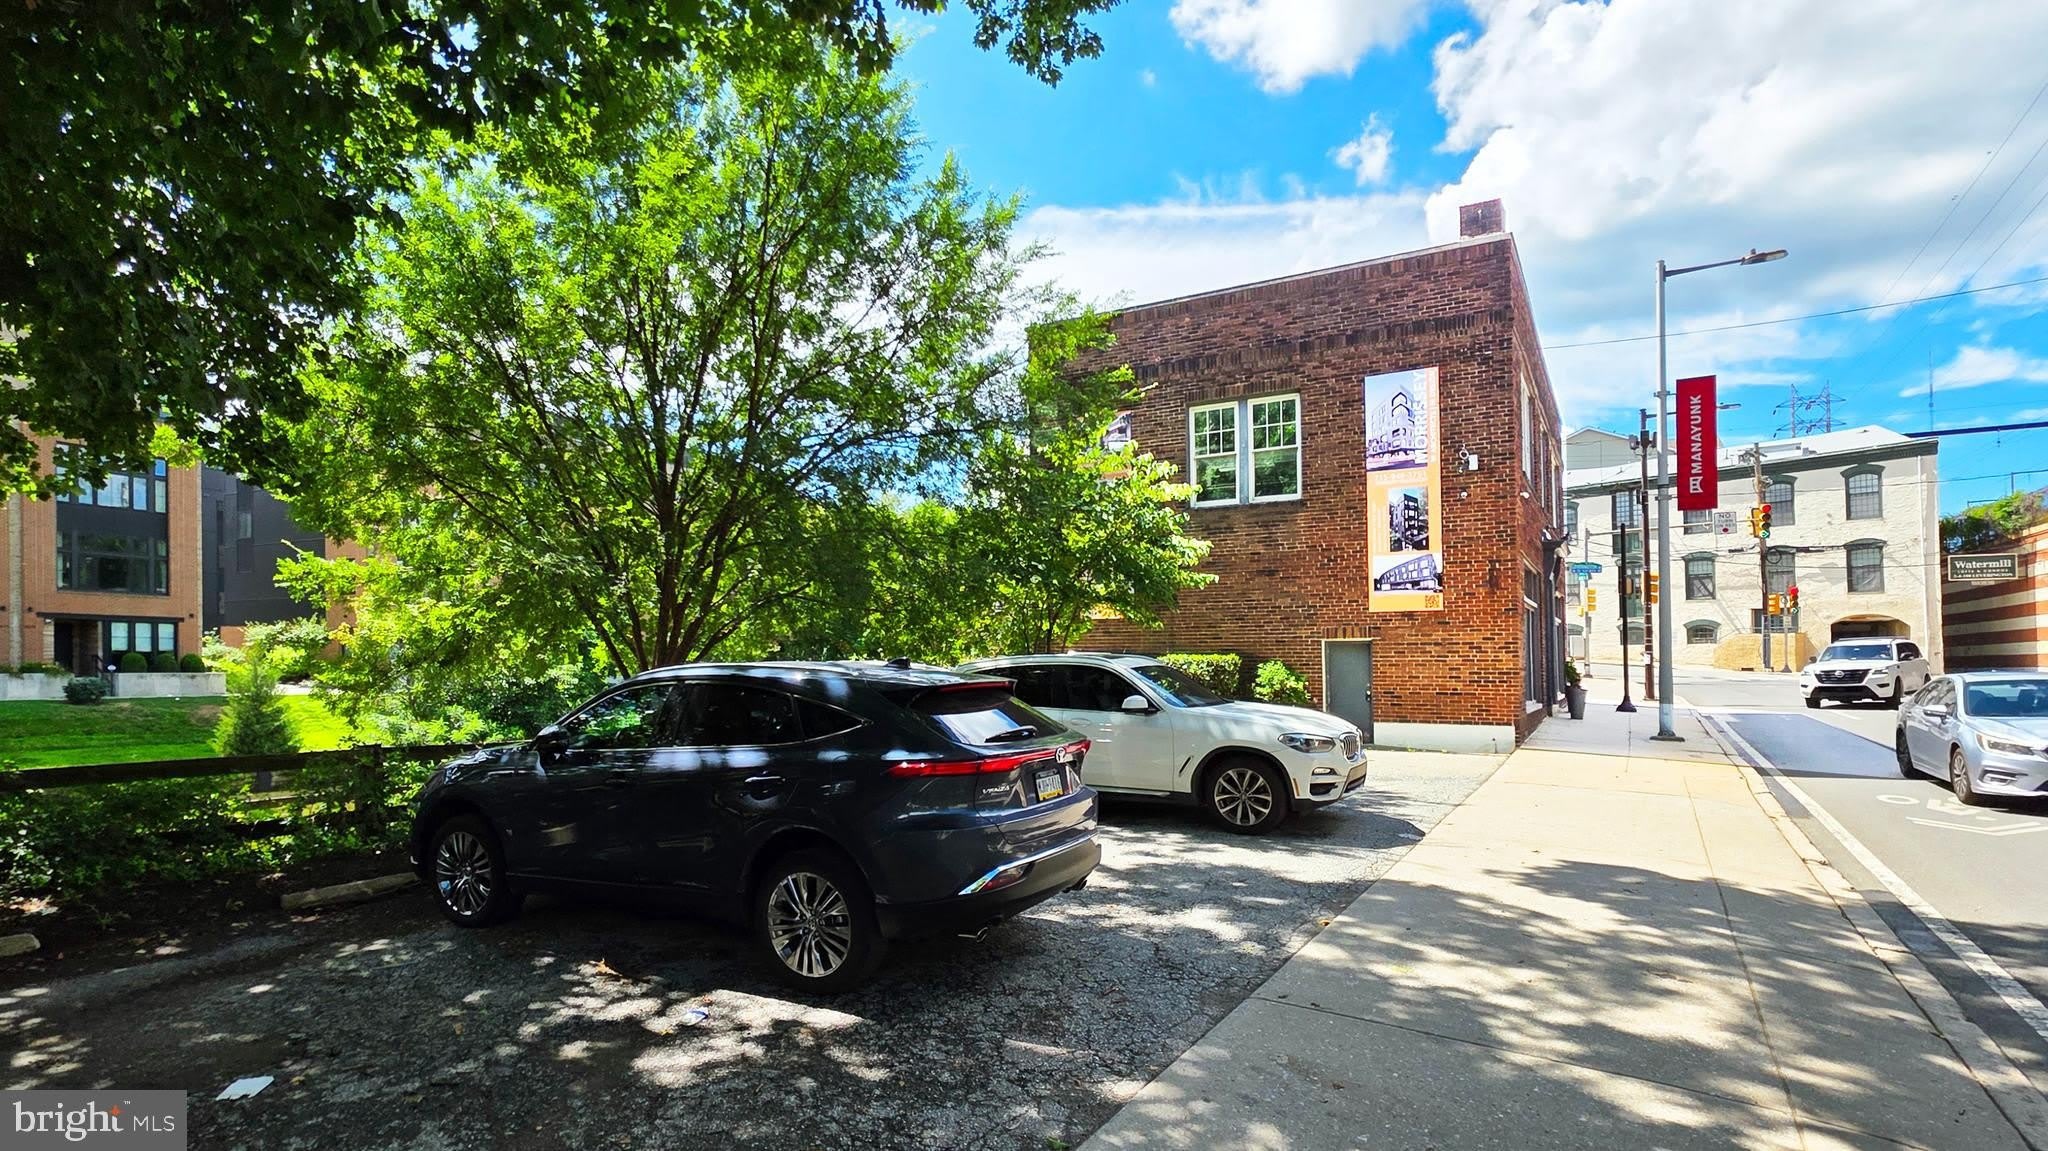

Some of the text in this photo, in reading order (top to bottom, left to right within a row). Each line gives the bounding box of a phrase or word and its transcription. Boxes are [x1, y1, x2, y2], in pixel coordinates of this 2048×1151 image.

[1414, 371, 1428, 464] MORRISSEY
[1690, 394, 1703, 474] MANAYUNK
[1954, 559, 2012, 569] Watermill
